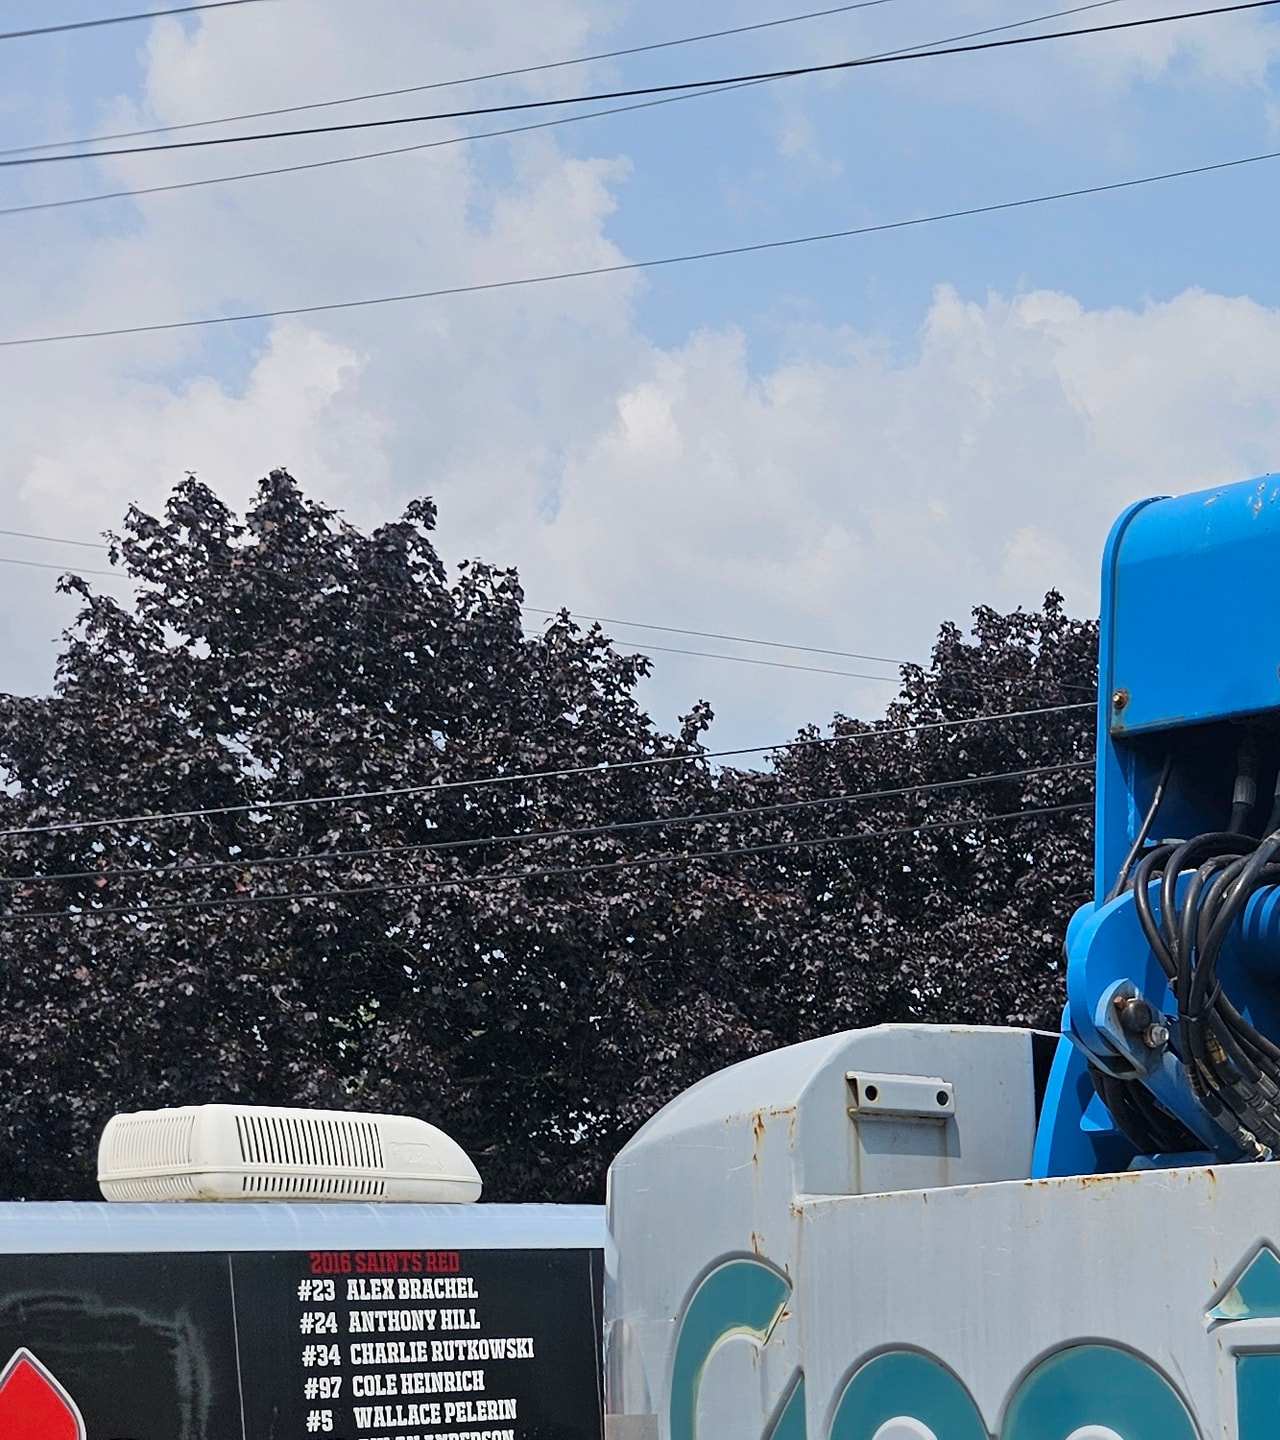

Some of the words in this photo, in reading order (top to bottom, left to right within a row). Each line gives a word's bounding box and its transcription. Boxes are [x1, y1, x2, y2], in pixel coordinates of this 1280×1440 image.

[310, 1252, 350, 1273] 2016
[355, 1252, 422, 1272] SAINTS
[425, 1252, 460, 1272] RED
[297, 1279, 335, 1301] #23
[347, 1279, 395, 1300] ALEX
[398, 1277, 478, 1299] BRACHEL
[300, 1311, 338, 1334] #24
[349, 1310, 437, 1332] ANTHONY
[440, 1309, 481, 1330] HILL
[302, 1344, 342, 1366] #34
[350, 1341, 428, 1365] CHARLIE
[431, 1338, 534, 1362] RUTKOWSKI
[304, 1376, 342, 1399] #97
[352, 1374, 397, 1397] COLE
[400, 1370, 485, 1395] HEINRICH
[306, 1410, 333, 1432] #5
[353, 1403, 442, 1428] WALLACE
[444, 1399, 517, 1424] PELERIN
